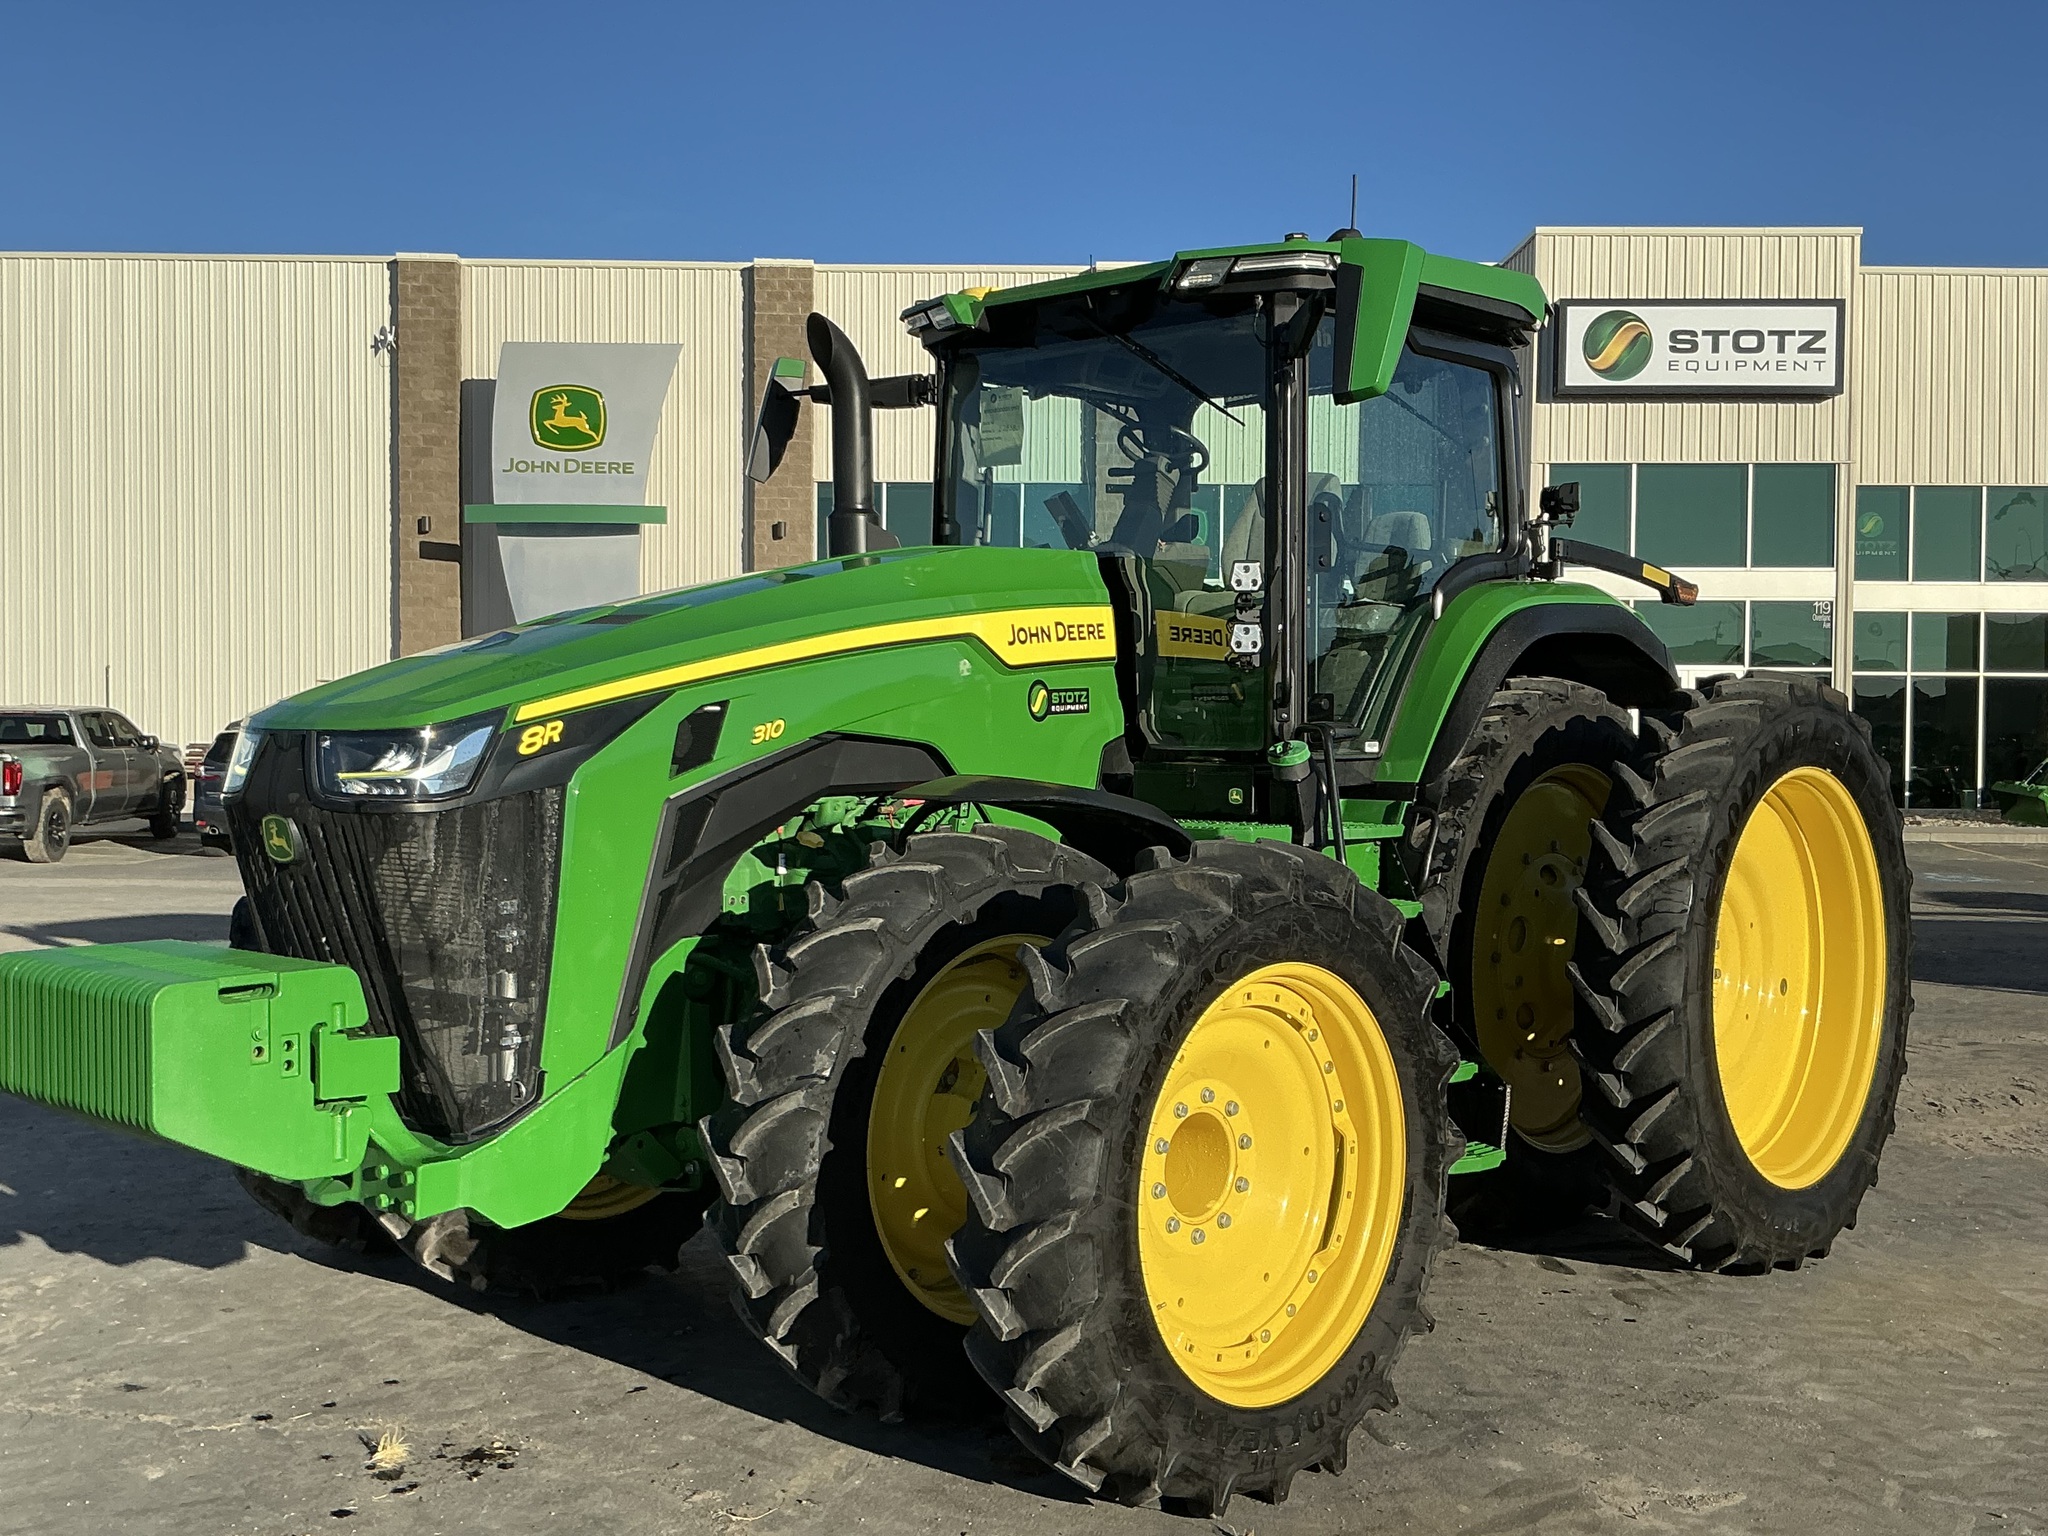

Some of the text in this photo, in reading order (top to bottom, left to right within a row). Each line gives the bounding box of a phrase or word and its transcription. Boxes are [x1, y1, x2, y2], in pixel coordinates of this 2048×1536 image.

[1668, 329, 1827, 355] STOTZ
[1668, 360, 1827, 373] EQUIPMENT
[502, 457, 635, 475] JOHN DEERE
[1855, 540, 1897, 550] TOTZ
[1812, 601, 1831, 615] 119
[1007, 621, 1106, 646] JOHN DEERE
[1051, 691, 1088, 704] STOTZ
[1051, 703, 1088, 712] EQUIPMENT
[518, 720, 564, 755] 8R
[751, 718, 785, 746] 310
